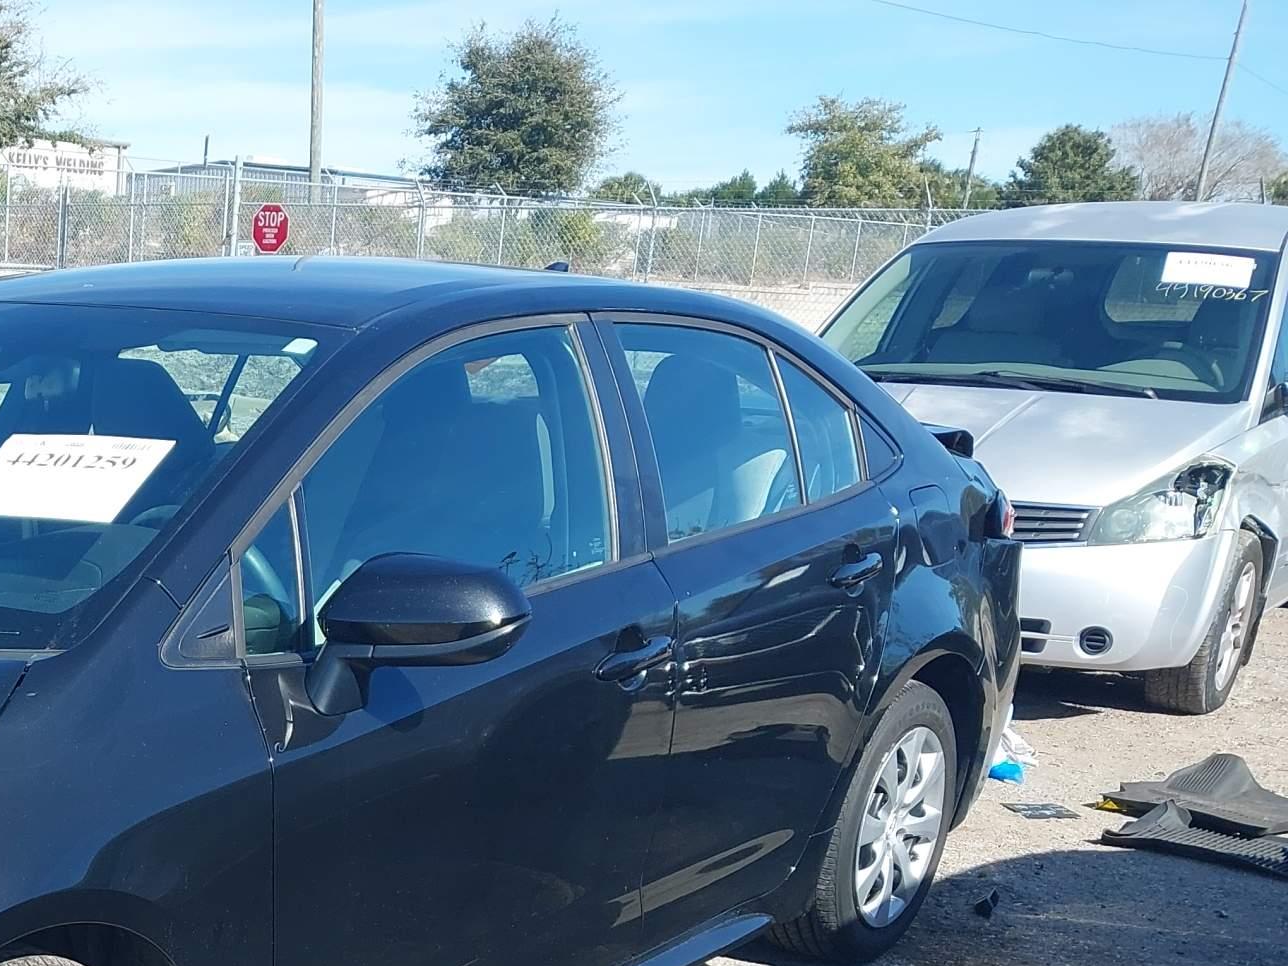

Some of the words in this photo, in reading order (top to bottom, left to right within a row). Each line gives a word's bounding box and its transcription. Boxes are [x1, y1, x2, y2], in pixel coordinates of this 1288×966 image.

[8, 151, 49, 171] KELLY'S
[55, 155, 105, 176] WELDING
[258, 211, 285, 227] STOP
[7, 452, 138, 470] 44201259
